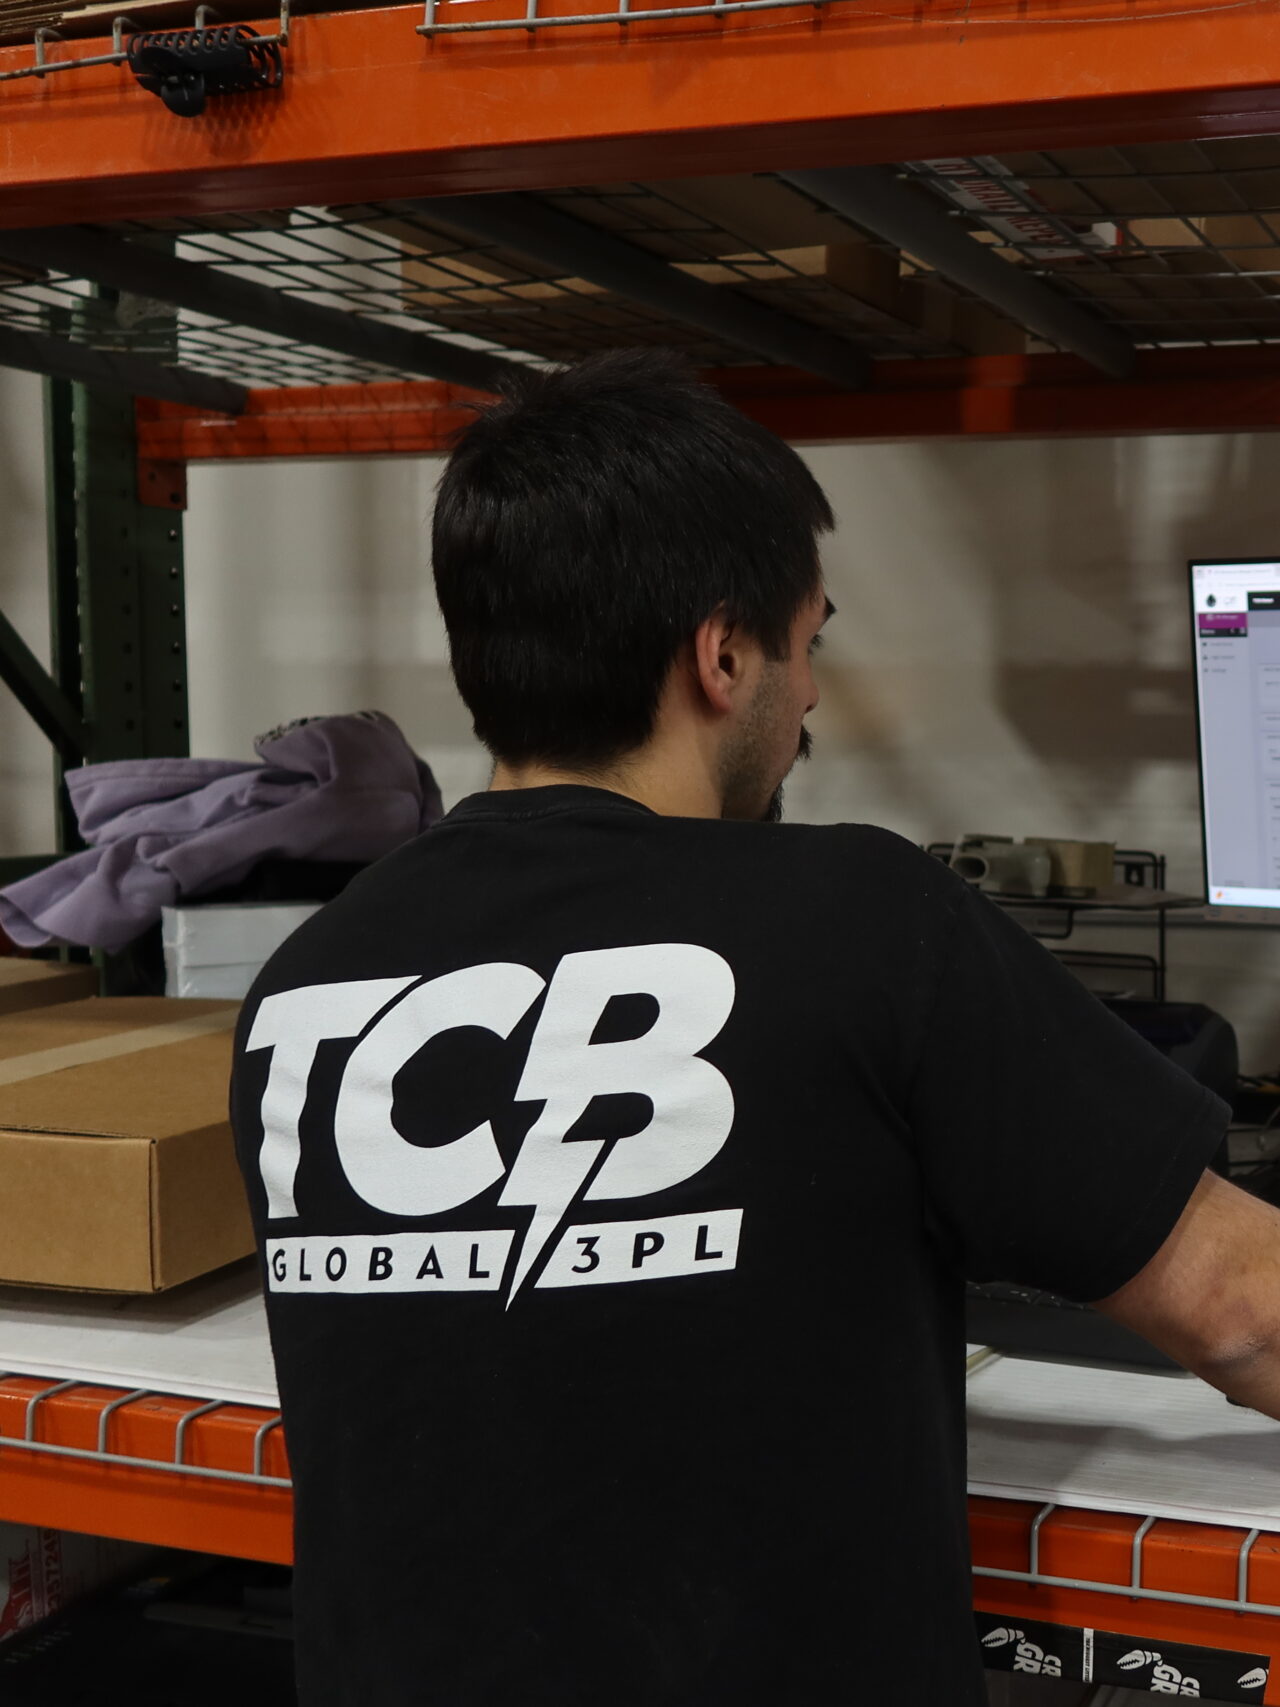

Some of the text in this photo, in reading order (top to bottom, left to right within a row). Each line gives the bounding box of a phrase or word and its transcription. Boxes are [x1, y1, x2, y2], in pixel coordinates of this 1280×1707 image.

[244, 943, 736, 1222] TCB
[272, 1224, 724, 1283] GLOBAL 3PL
